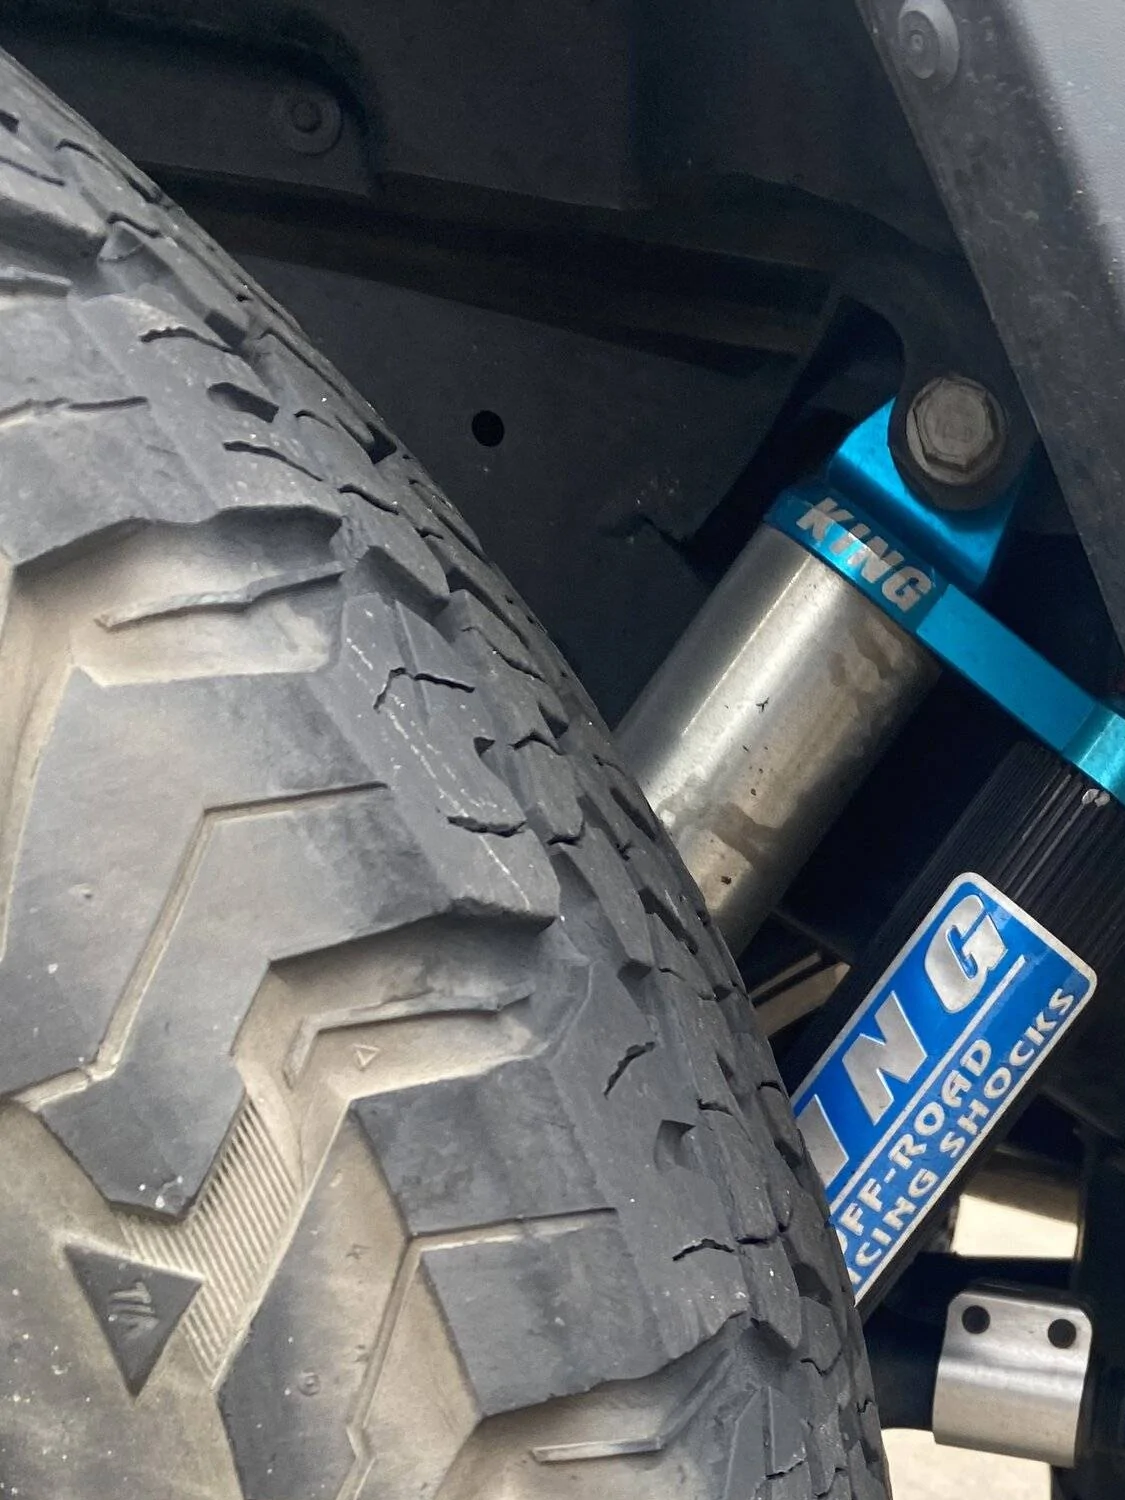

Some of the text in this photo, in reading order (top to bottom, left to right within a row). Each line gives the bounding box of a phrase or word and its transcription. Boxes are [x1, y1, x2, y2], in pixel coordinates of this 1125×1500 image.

[796, 497, 932, 613] KING
[796, 894, 1008, 1189] ING
[847, 987, 1075, 1285] CING SHOCKS
